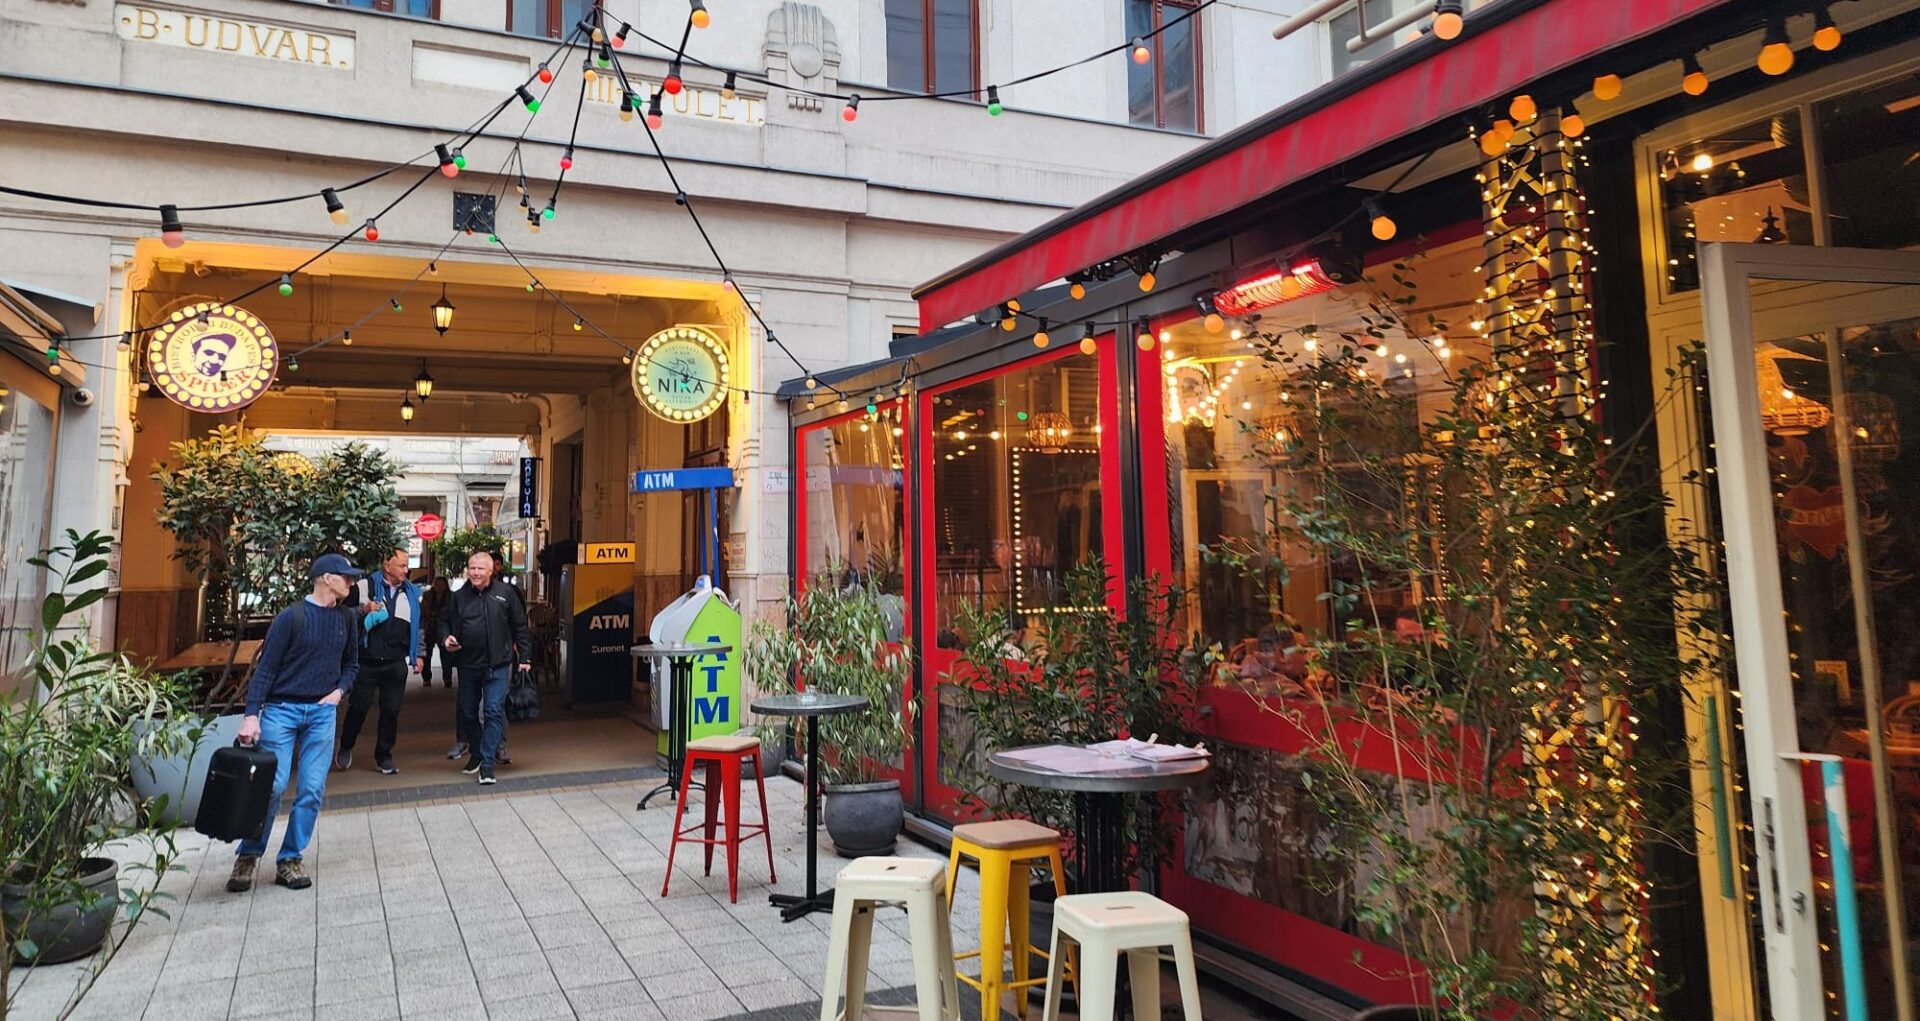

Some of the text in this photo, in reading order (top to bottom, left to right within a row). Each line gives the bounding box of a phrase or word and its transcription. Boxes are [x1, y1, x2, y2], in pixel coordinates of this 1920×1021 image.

[184, 15, 348, 67] UDVAR.
[644, 472, 674, 489] ATM
[596, 547, 628, 559] ATM
[589, 614, 630, 630] ATM
[592, 644, 625, 654] Euronet
[694, 635, 730, 725] ATM
